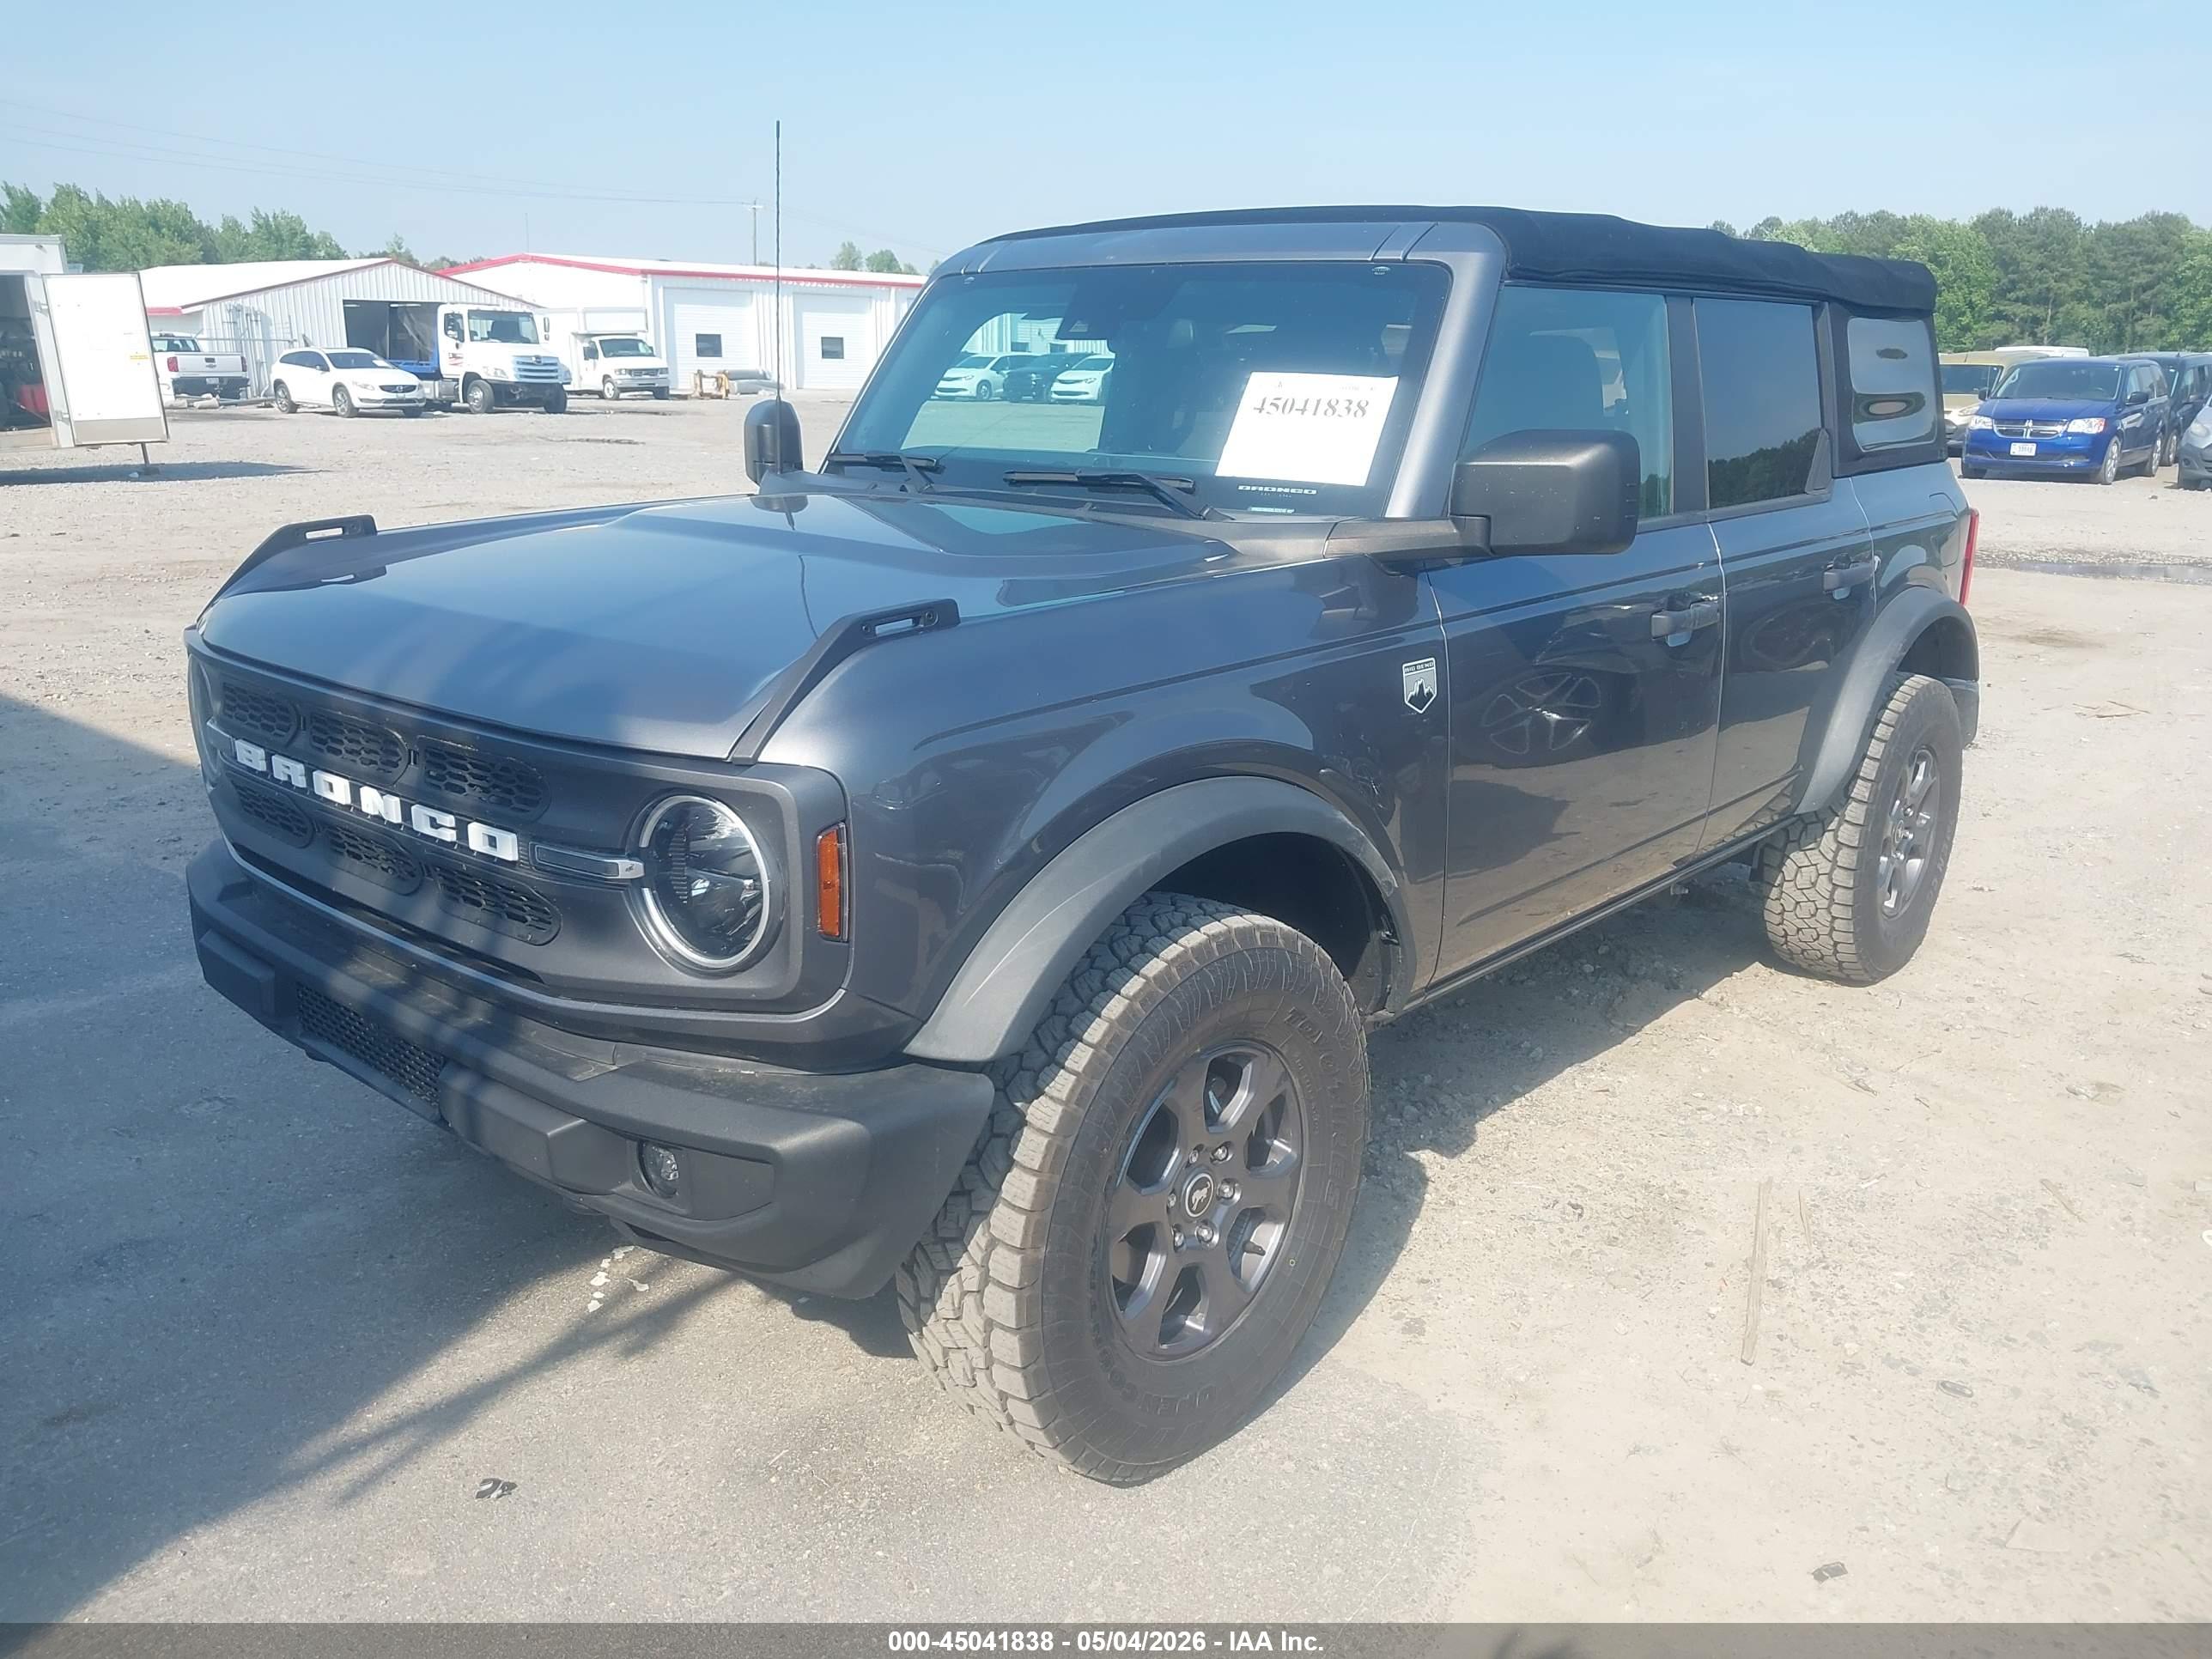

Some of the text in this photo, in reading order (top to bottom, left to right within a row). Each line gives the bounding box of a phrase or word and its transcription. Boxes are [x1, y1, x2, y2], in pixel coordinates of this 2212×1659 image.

[1253, 396, 1370, 418] 45041838
[1237, 485, 1317, 495] BRONCO
[234, 738, 519, 862] BRONCO
